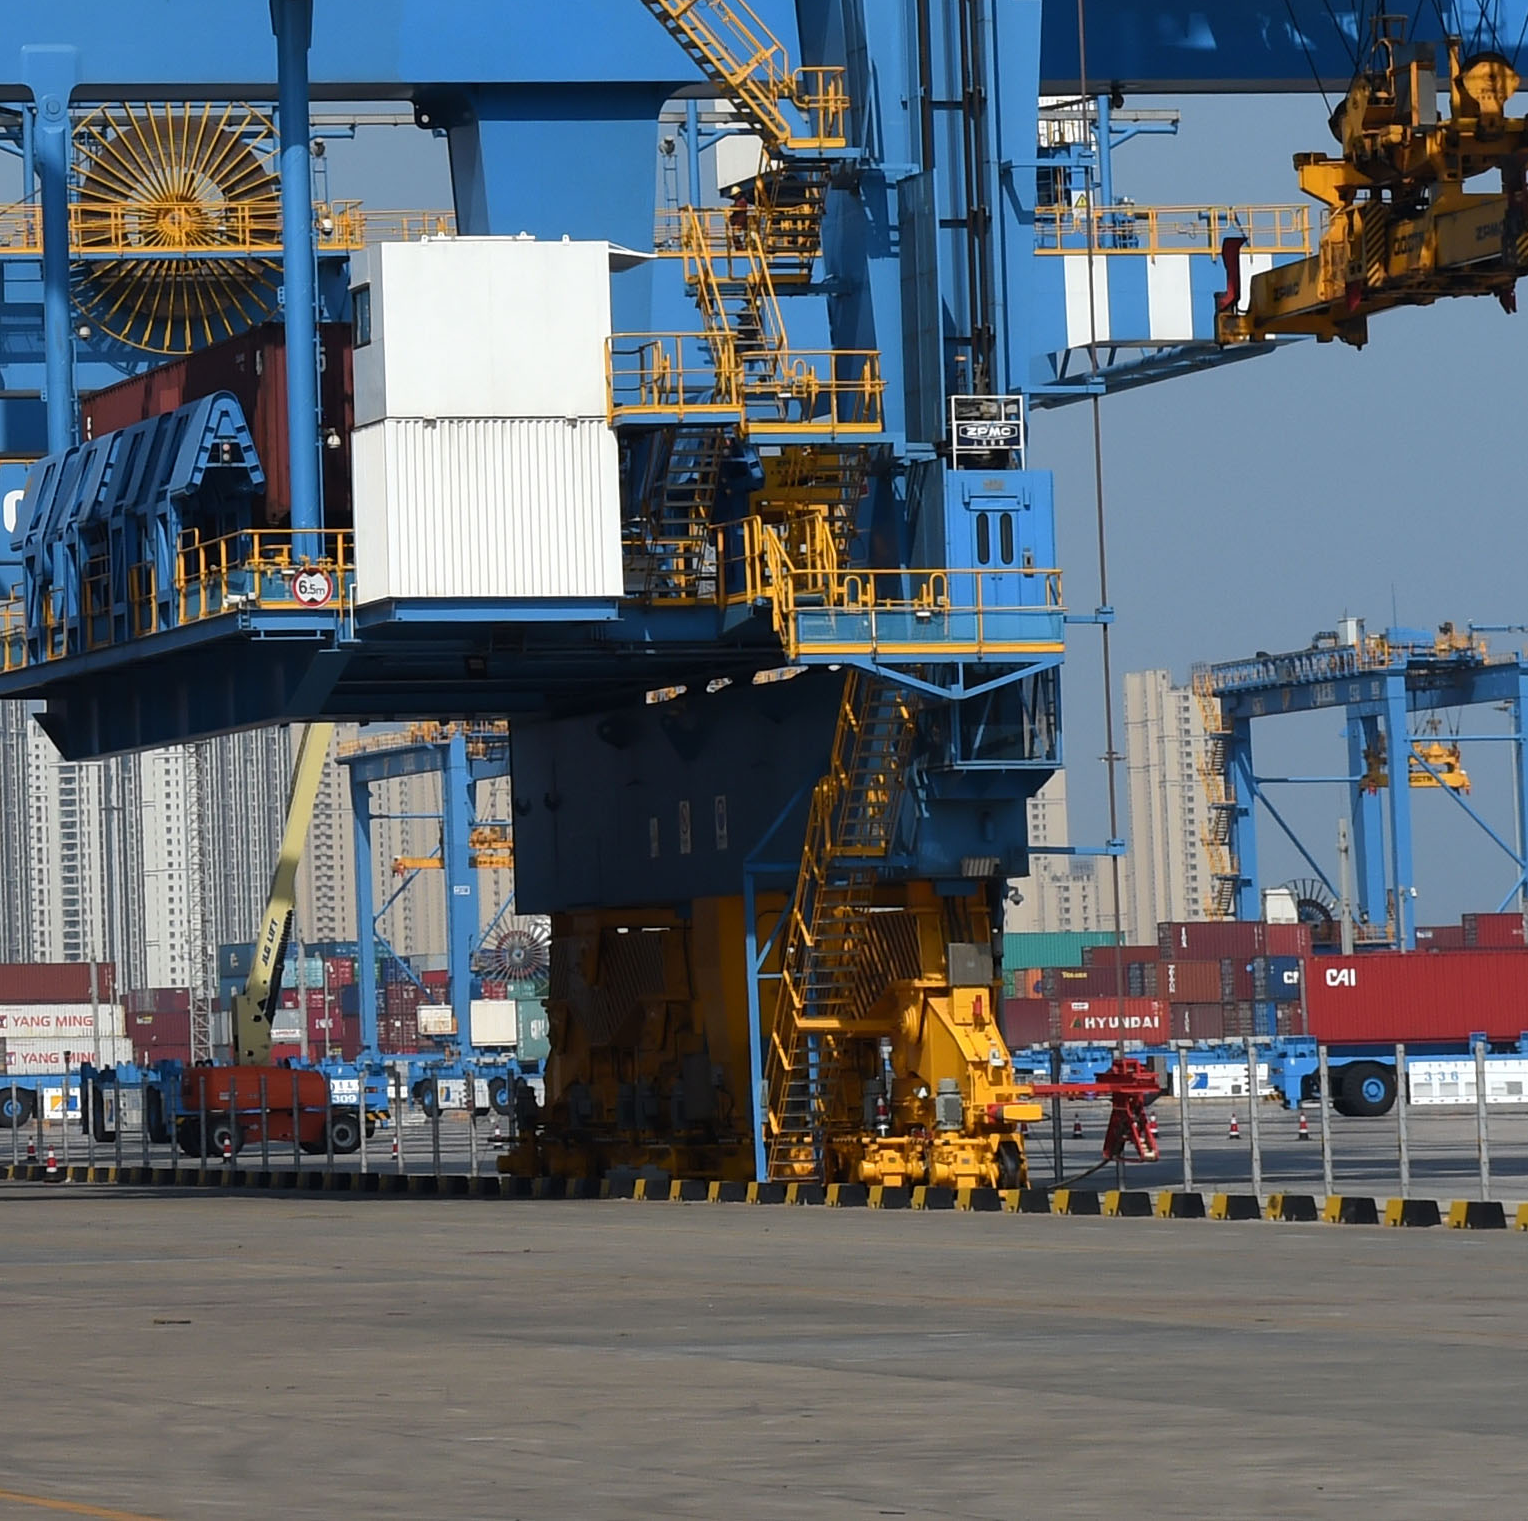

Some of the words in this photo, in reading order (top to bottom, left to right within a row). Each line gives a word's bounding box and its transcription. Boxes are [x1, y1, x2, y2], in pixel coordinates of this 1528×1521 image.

[966, 426, 1011, 437] ZPMC
[262, 945, 273, 967] JLG
[268, 918, 279, 944] LIFT
[1325, 968, 1357, 987] CAI
[12, 1015, 51, 1027] YANG
[55, 1015, 94, 1027] MING
[1084, 1016, 1160, 1029] HYUNDAI
[21, 1052, 59, 1064] YANG
